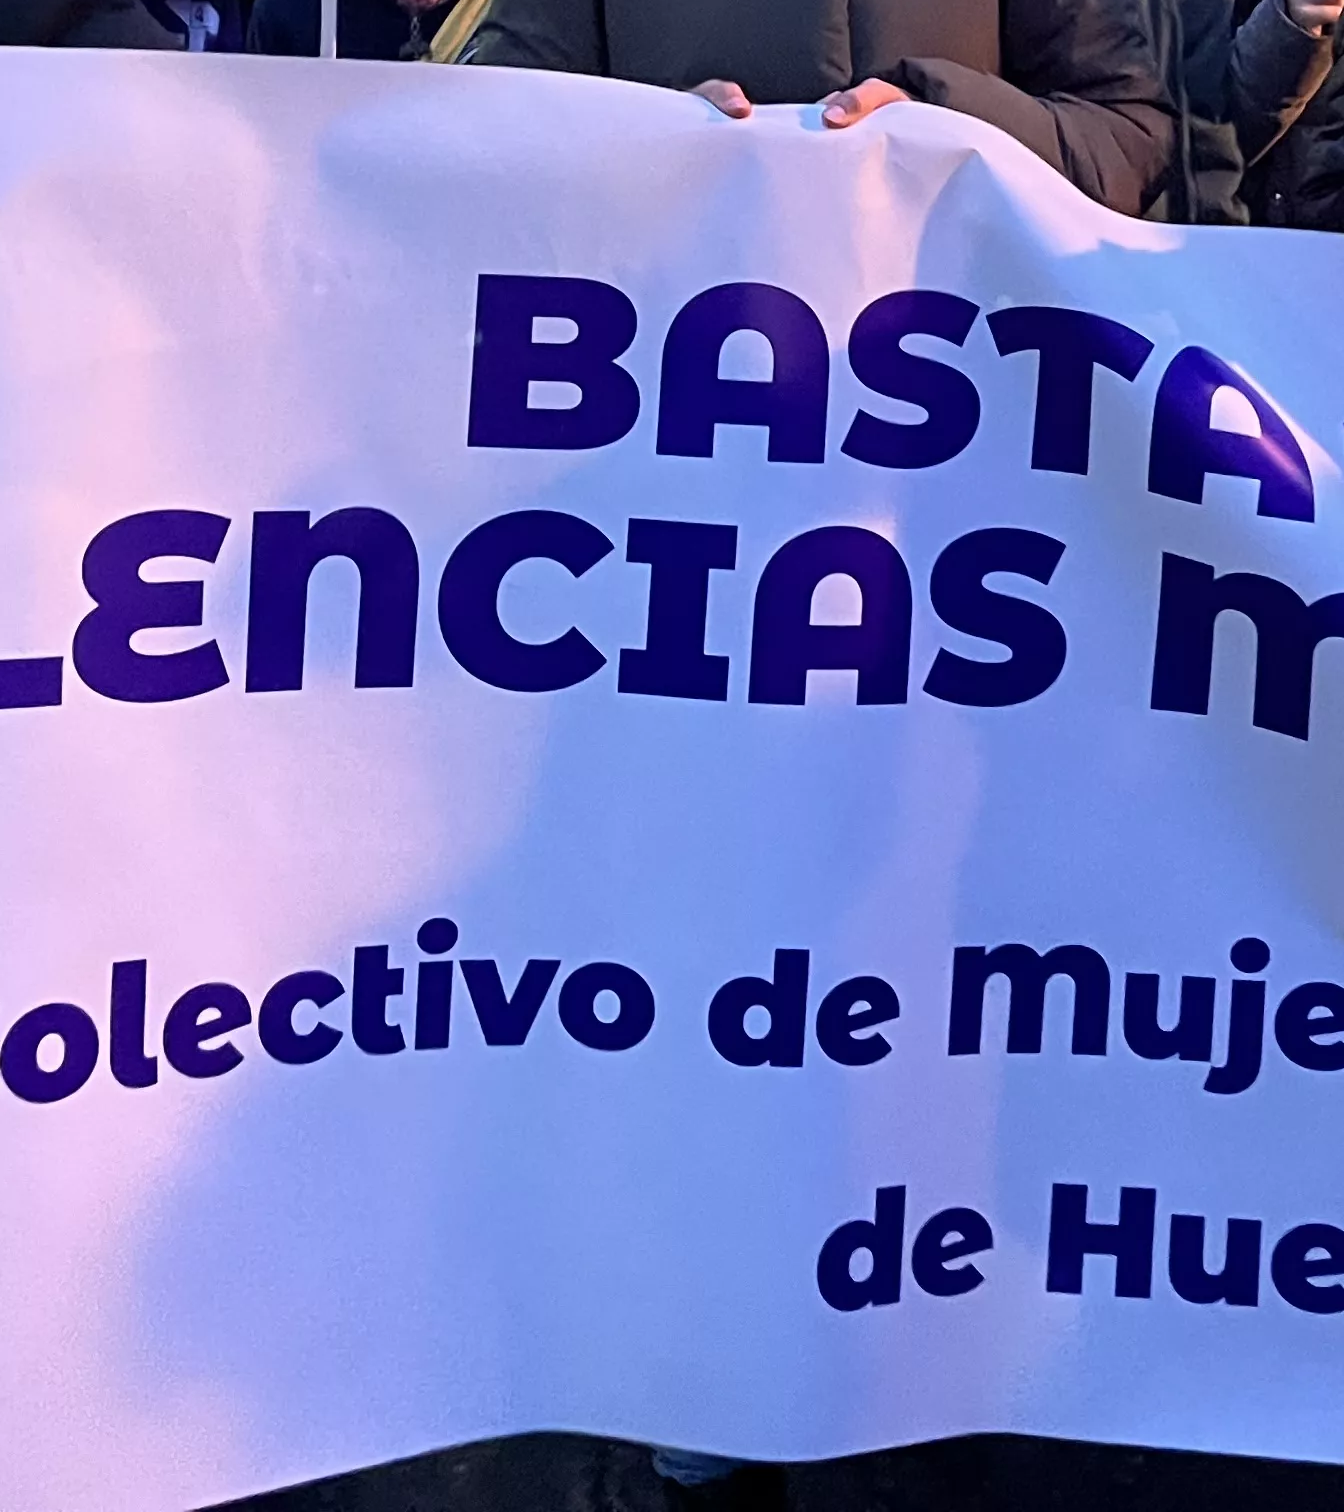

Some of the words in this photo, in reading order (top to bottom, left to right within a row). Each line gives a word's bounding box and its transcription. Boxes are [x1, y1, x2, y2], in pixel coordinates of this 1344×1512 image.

[467, 273, 1316, 524] BASTA
[706, 949, 901, 1068] de
[815, 1184, 995, 1312] de
